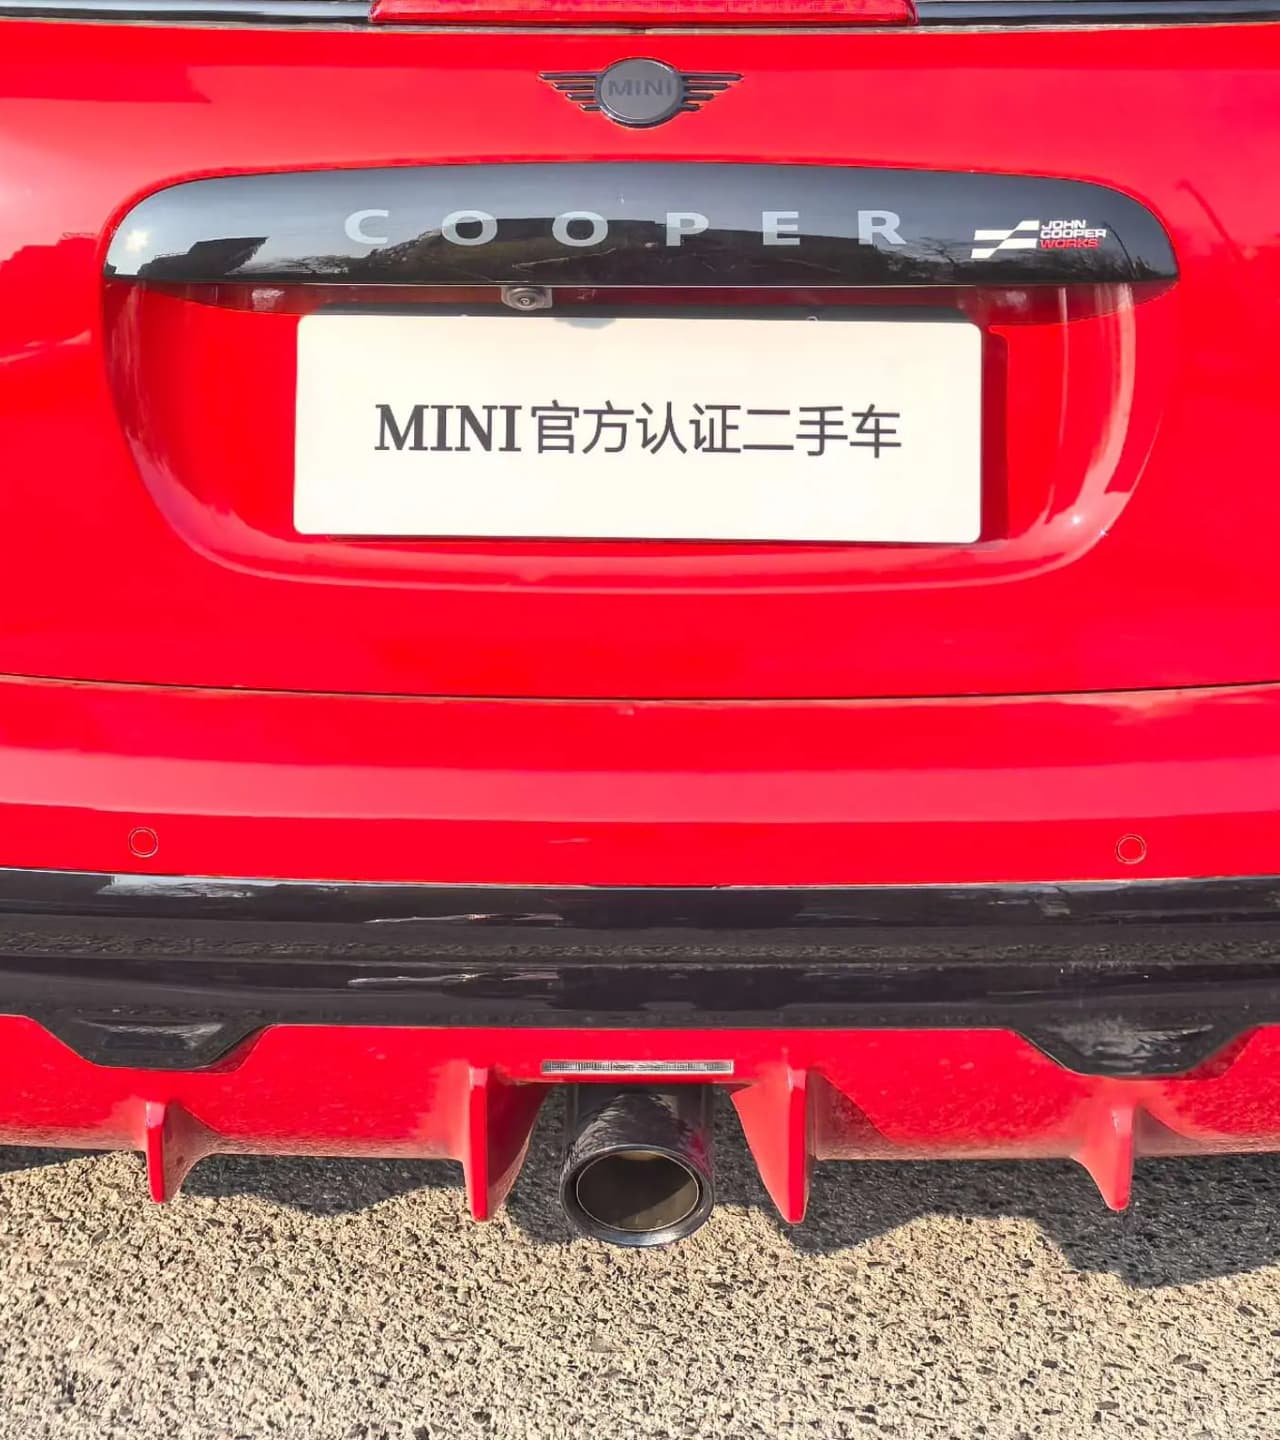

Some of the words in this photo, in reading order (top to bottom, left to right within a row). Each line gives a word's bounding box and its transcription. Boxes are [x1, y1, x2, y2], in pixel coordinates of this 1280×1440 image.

[608, 78, 671, 98] MINI
[344, 208, 907, 247] COOPER
[1041, 219, 1087, 230] JOHN
[1039, 228, 1107, 239] COOPER
[1039, 239, 1099, 249] WORKS
